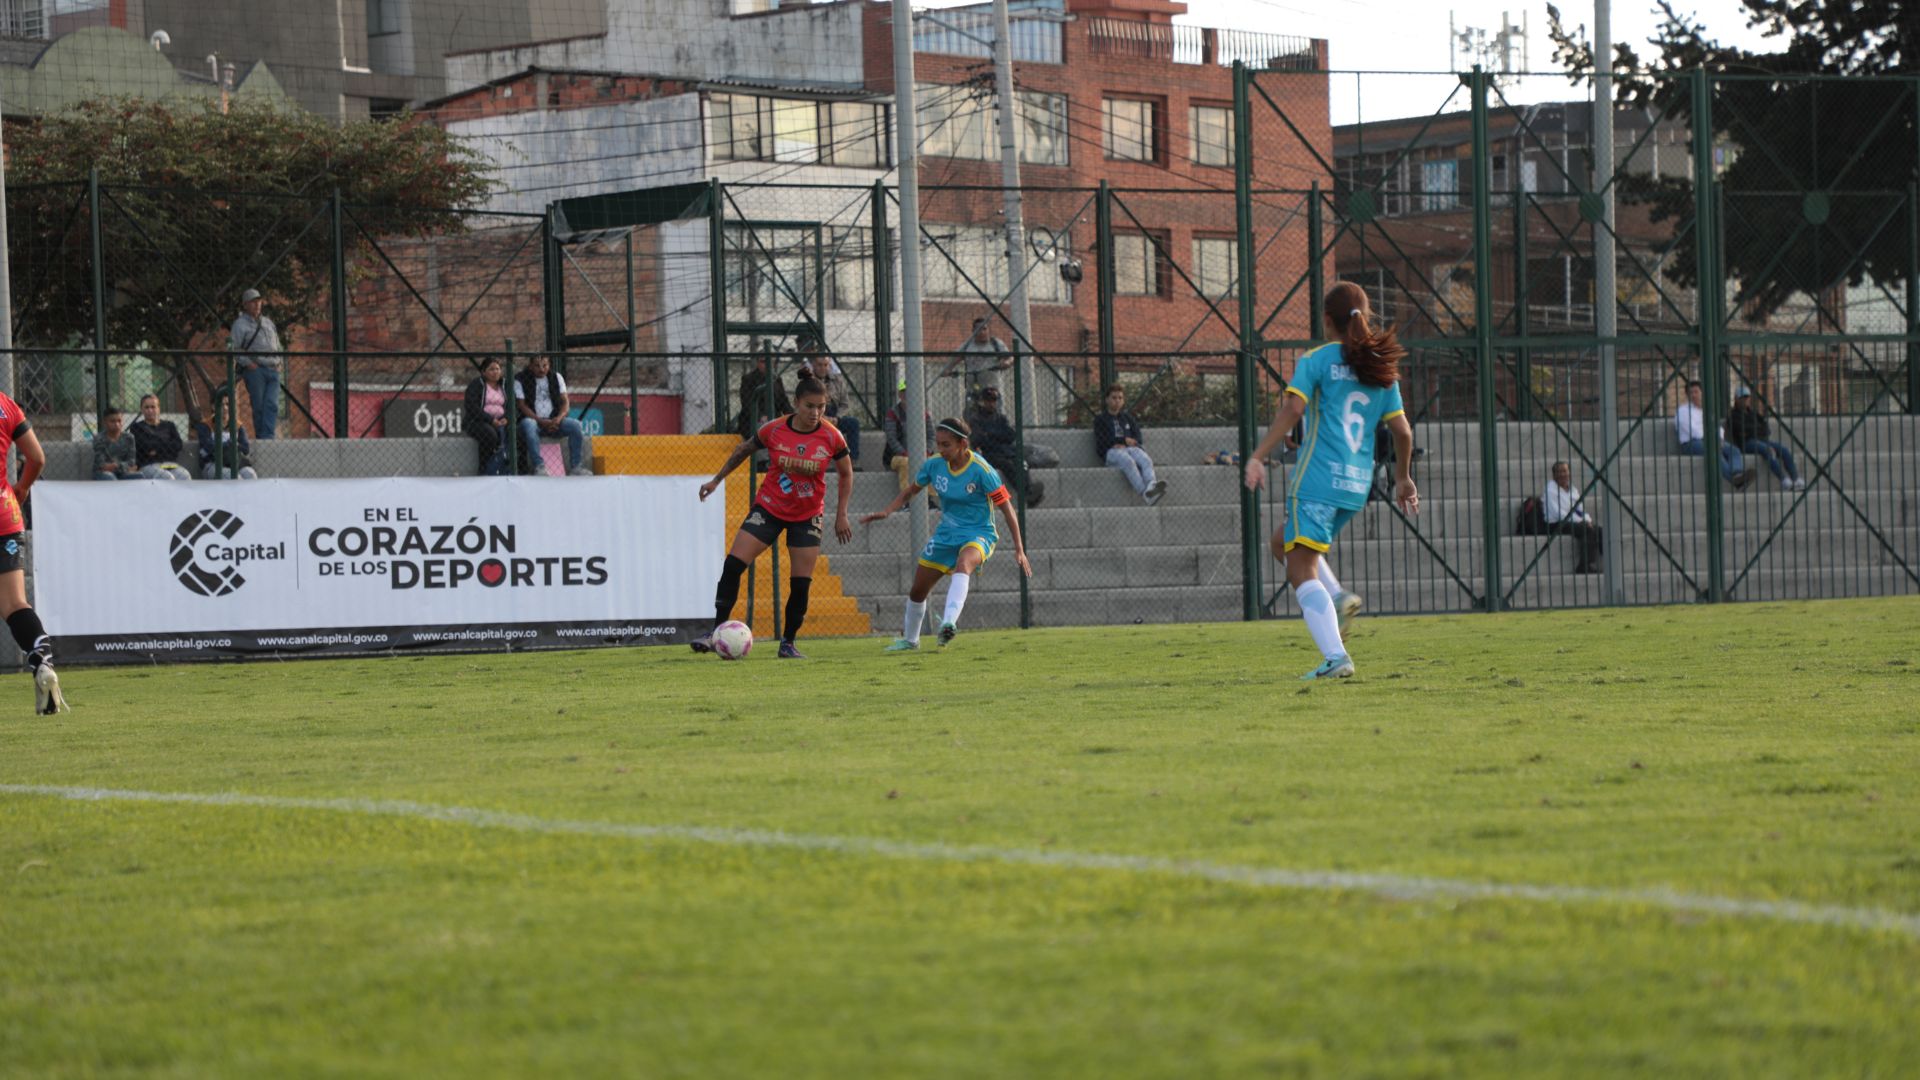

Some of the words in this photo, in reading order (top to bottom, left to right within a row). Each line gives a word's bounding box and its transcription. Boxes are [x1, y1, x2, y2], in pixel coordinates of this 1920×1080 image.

[414, 402, 462, 439] Ópti
[1342, 391, 1371, 455] 6
[778, 455, 821, 472] FUTURE
[935, 474, 949, 493] 53
[364, 508, 390, 522] EN
[396, 508, 419, 521] EL
[309, 516, 516, 558] CORAZÓN
[204, 542, 285, 566] Capital
[319, 562, 345, 576] DE
[351, 561, 388, 576] LOS
[391, 556, 609, 589] DEPORTES
[257, 632, 389, 647] www.canalcapital.gov.co
[413, 628, 538, 642] www.canalcapital.gov.co
[556, 624, 677, 638] www.canalcapital.gov.co
[95, 637, 232, 651] www.canalcapital.gov.co
